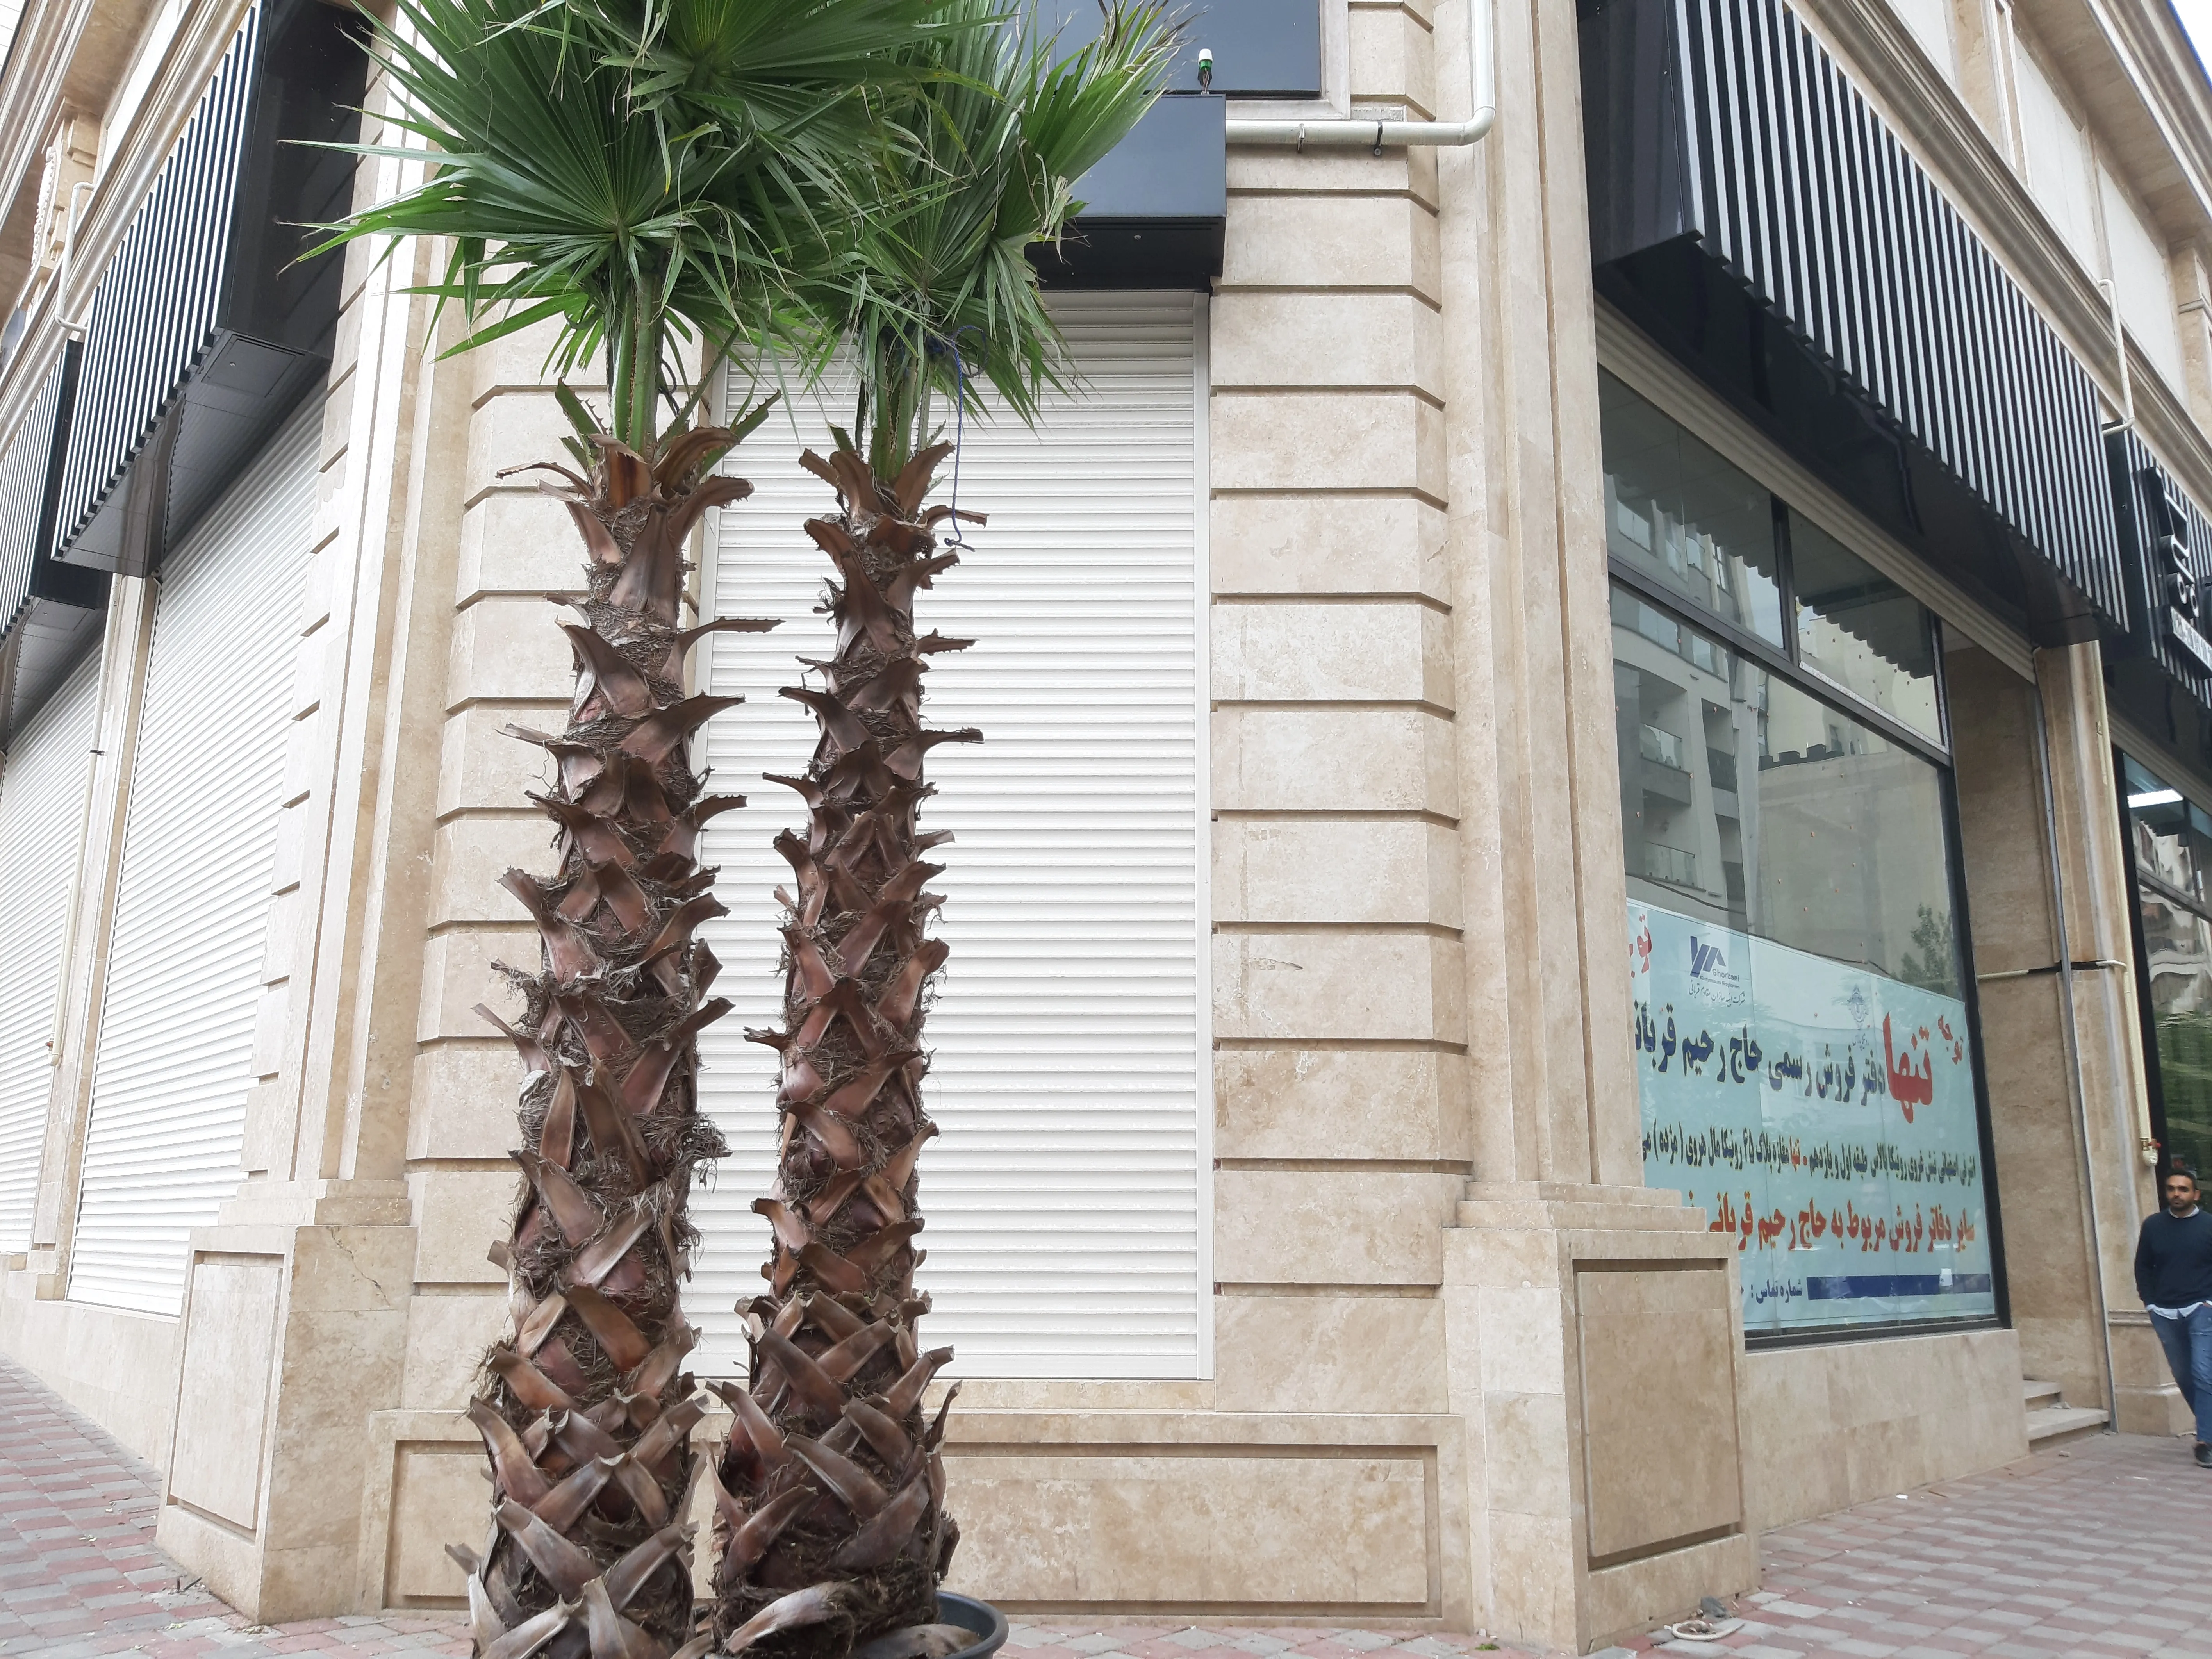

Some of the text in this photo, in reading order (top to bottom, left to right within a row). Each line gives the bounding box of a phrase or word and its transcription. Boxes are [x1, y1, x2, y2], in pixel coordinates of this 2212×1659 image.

[1689, 979, 1700, 999] قربانی
[1712, 968, 1740, 982] Ghorbani
[1733, 991, 1745, 1006] شرکت
[1634, 999, 1933, 1124] تنها دفتر فروش رسمی حاج رحیم قربان
[1686, 1132, 1706, 1167] هروی
[1708, 1125, 1720, 1167] مال
[1721, 1127, 1743, 1170] رونیکا
[1756, 1131, 1772, 1174] پلاک
[1772, 1134, 1789, 1174] مغازه
[1790, 1136, 1801, 1172] تنها
[1809, 1140, 1833, 1179] یازدهم
[1835, 1154, 1839, 1179] و
[1841, 1143, 1852, 1181] اول
[1853, 1145, 1868, 1180] طبقه
[1758, 1209, 1796, 1251] رحیم
[1799, 1197, 1827, 1249] حاج
[1831, 1208, 1843, 1250] به
[1846, 1199, 1886, 1252] مربوط
[1889, 1202, 1923, 1252] فروش
[1927, 1203, 1952, 1252] دفاتر
[1956, 1207, 1975, 1252] سایر
[1781, 1279, 1803, 1303] شماره
